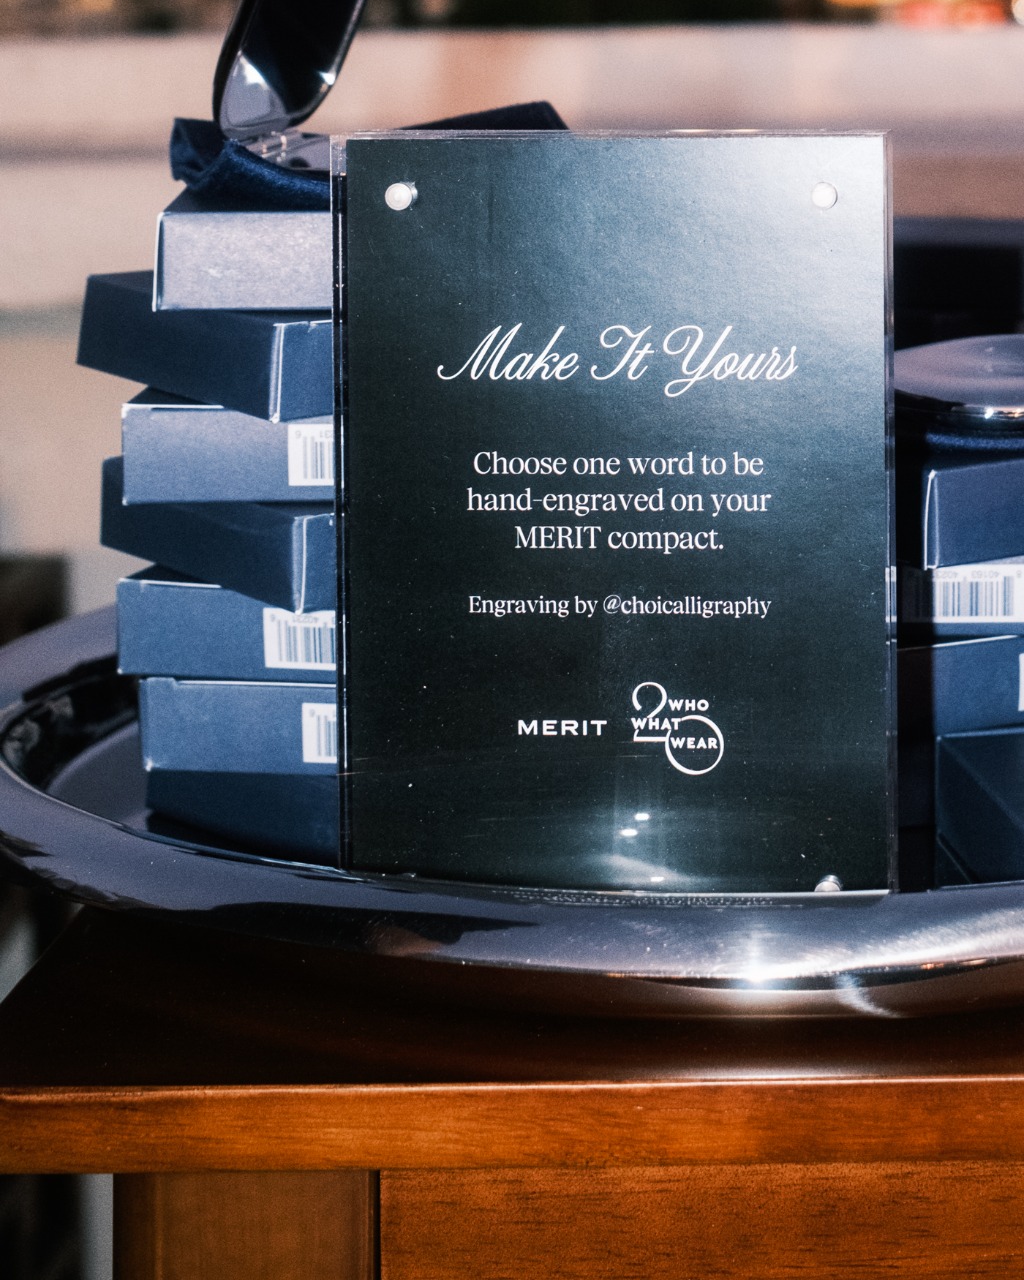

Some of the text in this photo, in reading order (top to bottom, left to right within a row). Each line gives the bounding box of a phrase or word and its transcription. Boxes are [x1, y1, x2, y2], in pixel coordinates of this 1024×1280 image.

[437, 322, 799, 398] Make It Yours
[473, 450, 767, 476] Choose one word to be
[466, 487, 772, 518] hand-engraved on your
[514, 526, 724, 555] MERIT compact.
[468, 594, 772, 619] Engraving by @choicalligraphy
[668, 699, 709, 712] WHO
[517, 719, 608, 737] MERIT
[630, 717, 682, 731] WHAT
[670, 737, 718, 750] WEAR
